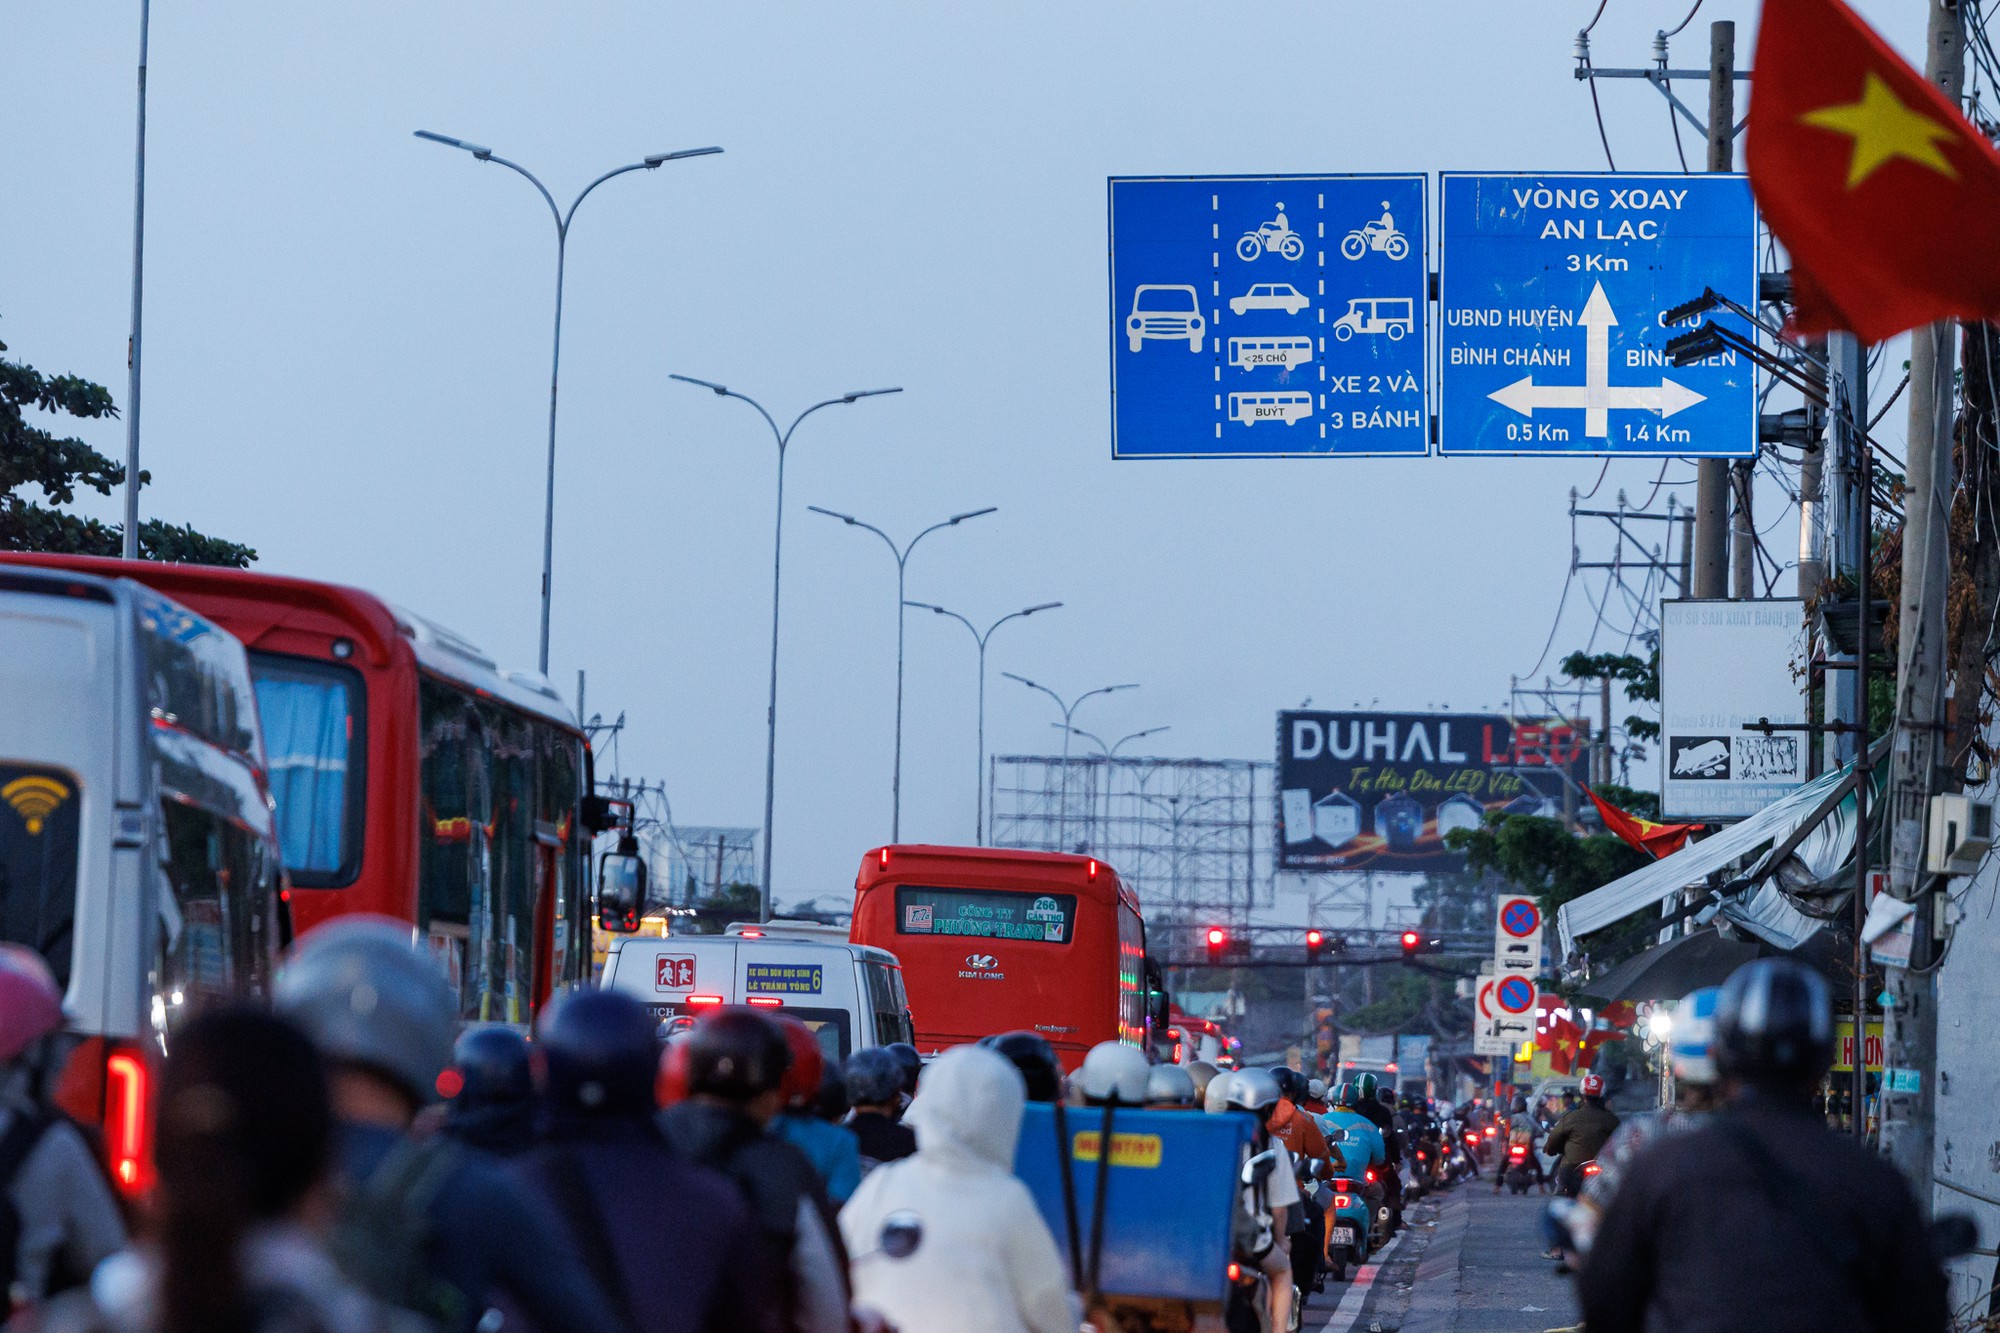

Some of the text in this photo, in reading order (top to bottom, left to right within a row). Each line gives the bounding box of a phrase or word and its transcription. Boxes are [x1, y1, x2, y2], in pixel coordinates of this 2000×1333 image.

[1512, 182, 1688, 210] VÒNG XOAY
[1540, 219, 1658, 247] AN LẠC
[1447, 305, 1573, 331] UBND HUYỆN
[1450, 342, 1571, 366] BÌNH CHÁNH
[1331, 369, 1419, 393] XE 2 VÀ
[1255, 407, 1285, 417] BUÝT
[1331, 405, 1420, 429] 3 BÁNH
[1538, 423, 1569, 441] Km
[1656, 425, 1690, 442] Km
[1292, 720, 1580, 764] DUHAL LED
[1443, 769, 1487, 793] LED
[958, 903, 1014, 919] CÔNG TY
[1036, 899, 1055, 911] 266
[933, 918, 1043, 939] PHƯƠNG TRANG
[812, 969, 821, 991] 6
[958, 970, 1005, 980] KIM LONG
